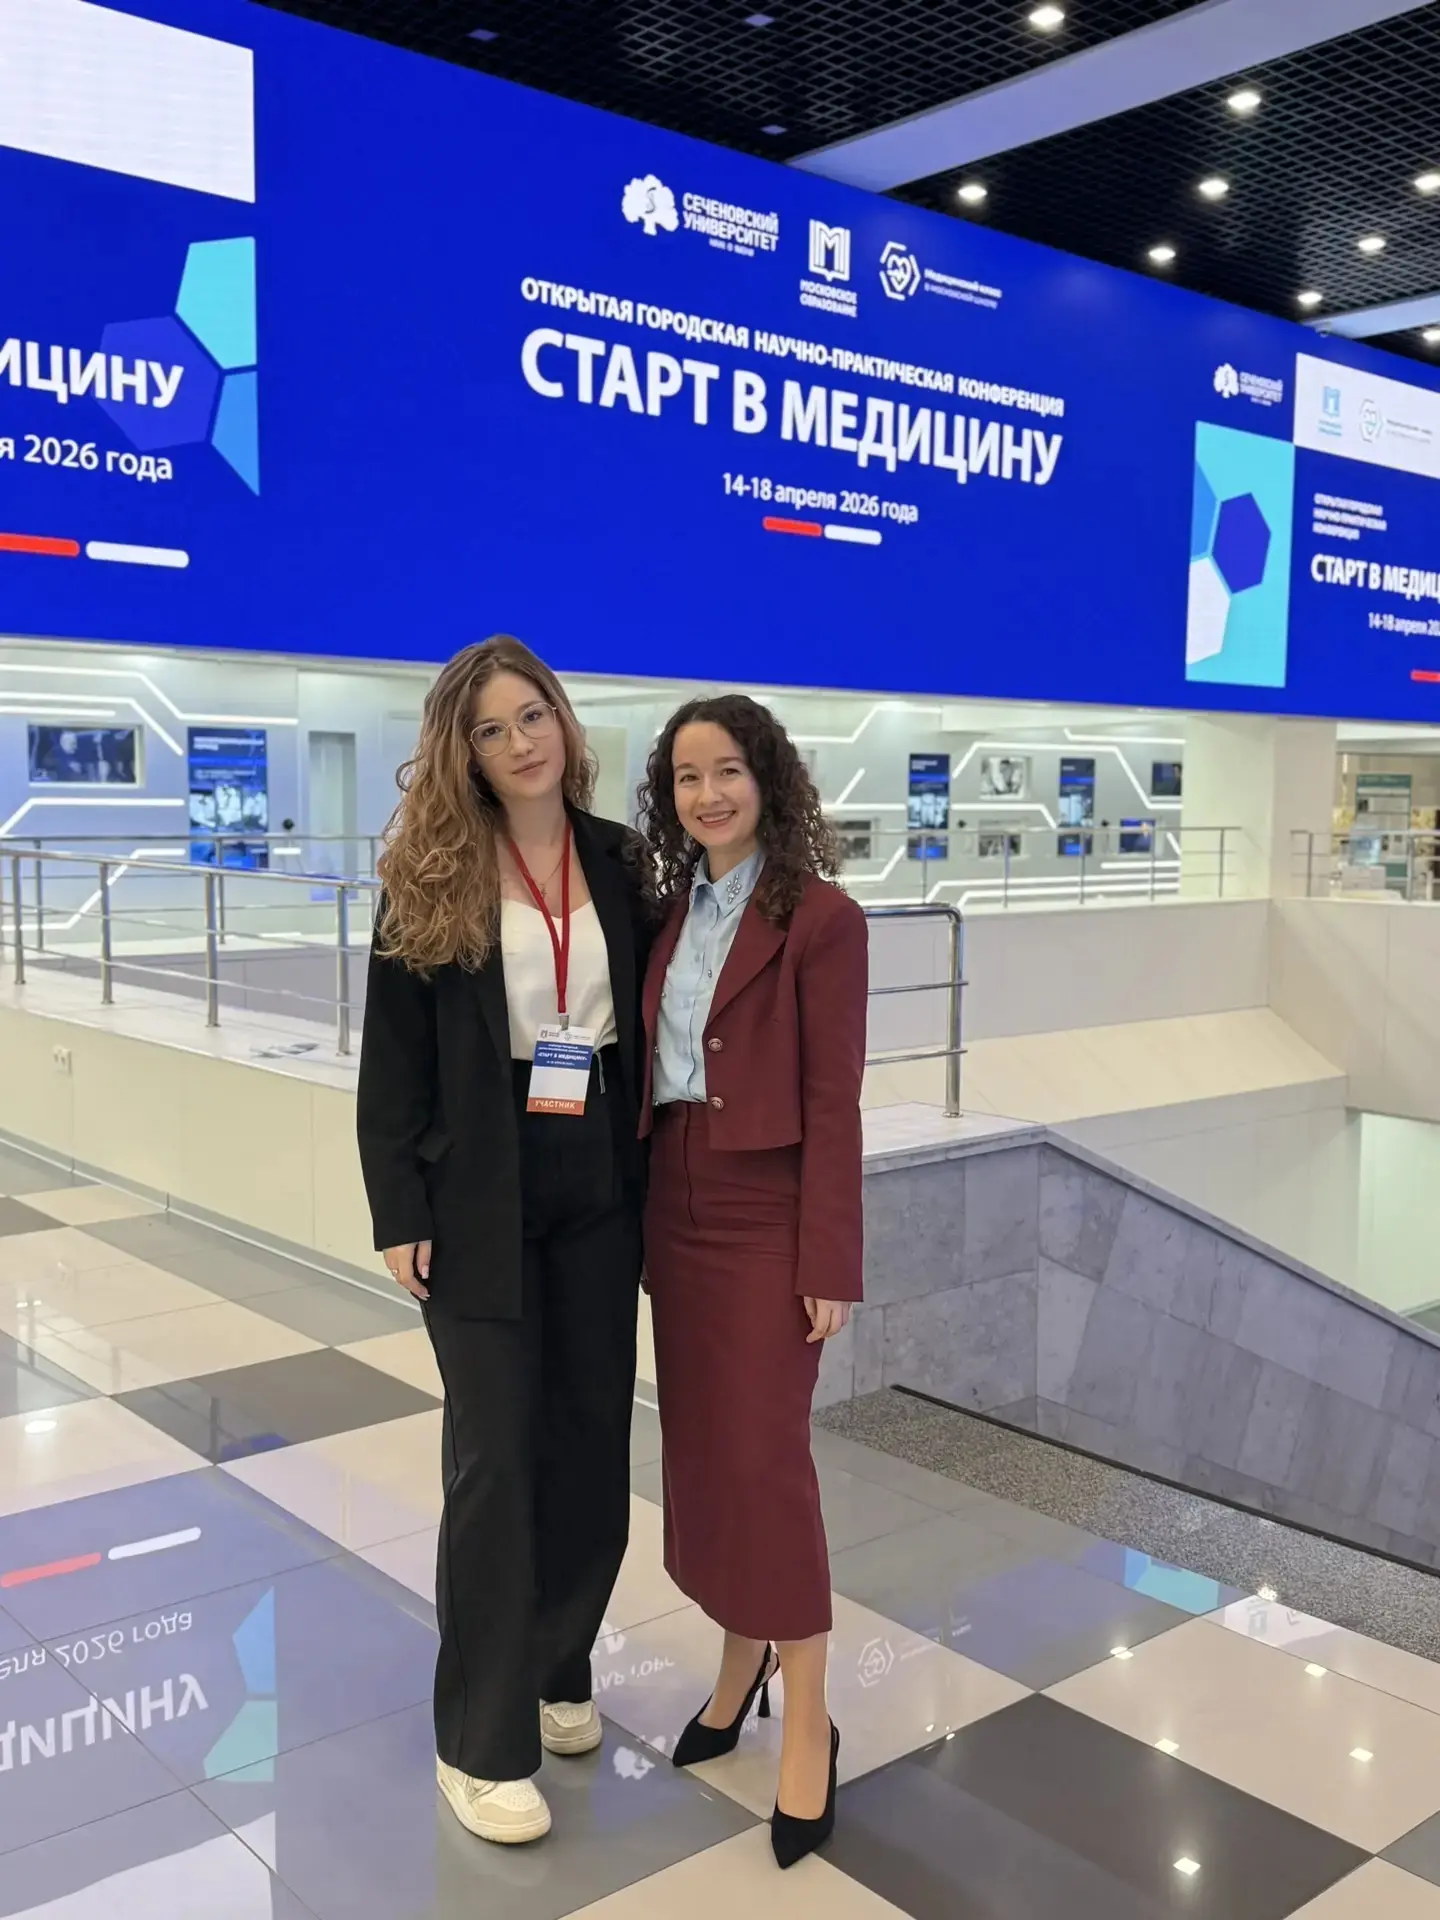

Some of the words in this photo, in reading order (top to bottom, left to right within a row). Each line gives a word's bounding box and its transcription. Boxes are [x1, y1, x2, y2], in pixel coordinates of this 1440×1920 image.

[683, 192, 778, 234] СЕЧЕНОВСКИЙ
[683, 210, 779, 251] УНИВЕРСИТЕТ
[521, 277, 633, 323] ОТКРЫТАЯ
[637, 303, 749, 349] ГОРОДСКАЯ
[754, 330, 954, 393] НАУЧНО-ПРАКТИЧЕСКАЯ
[958, 377, 1065, 417] КОНФЕРЕНЦИЯ
[521, 328, 719, 425] СТАРТ
[733, 369, 768, 434] В
[781, 379, 1062, 486] МЕДИЦИНУ
[24, 434, 98, 470] 2026
[106, 451, 173, 483] года
[723, 472, 772, 501] 14-18
[774, 485, 836, 510] апреля
[839, 490, 879, 517] 2026
[881, 501, 919, 524] года
[1311, 553, 1367, 587] СТАРТ
[1368, 562, 1381, 590] В
[535, 1100, 576, 1109] УЧАСТНИК
